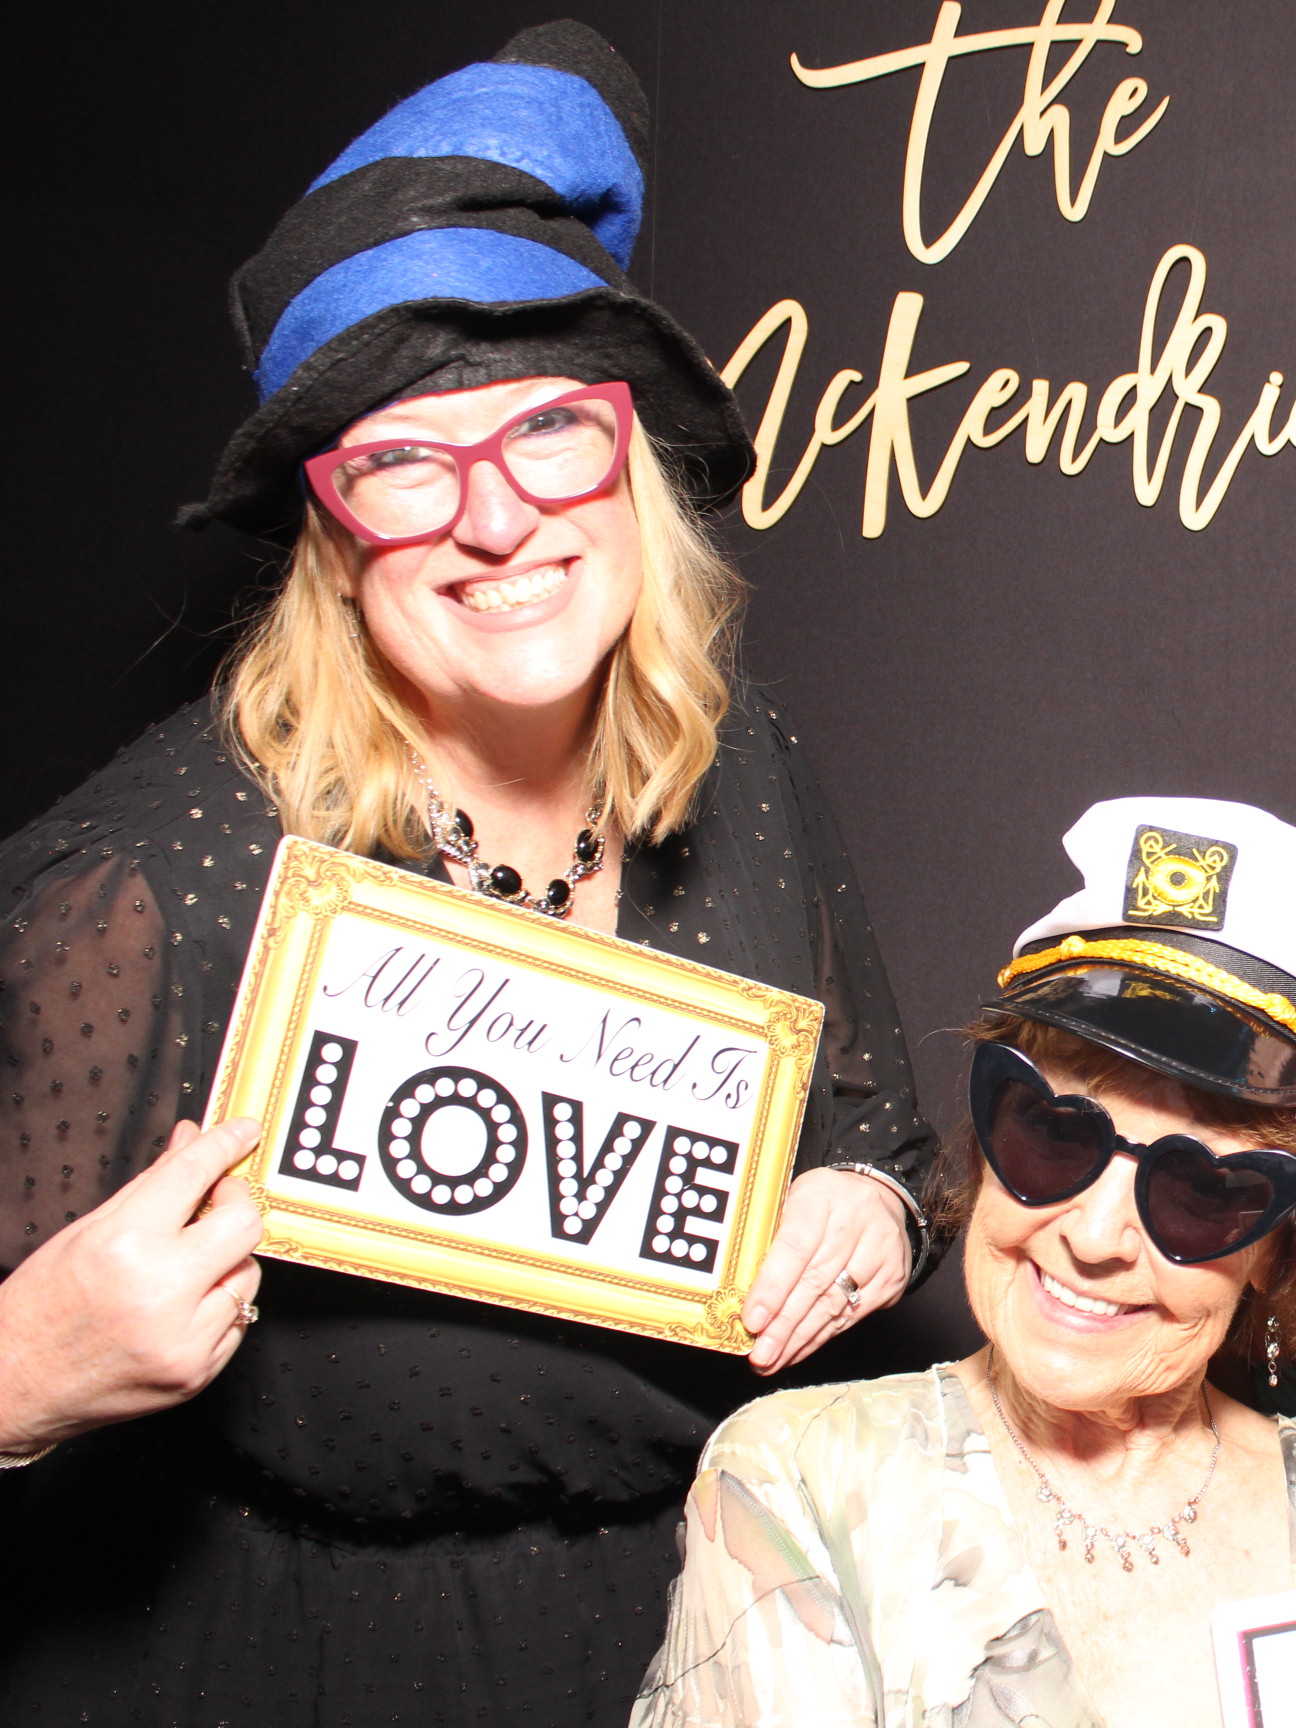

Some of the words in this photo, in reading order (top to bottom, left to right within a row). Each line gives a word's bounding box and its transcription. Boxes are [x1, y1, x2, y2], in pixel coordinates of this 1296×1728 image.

[790, 0, 1169, 264] the
[323, 946, 441, 1016] All
[424, 968, 551, 1057] You
[559, 1008, 701, 1091] Need
[691, 1046, 759, 1109] Is
[278, 1030, 740, 1275] LOVE
